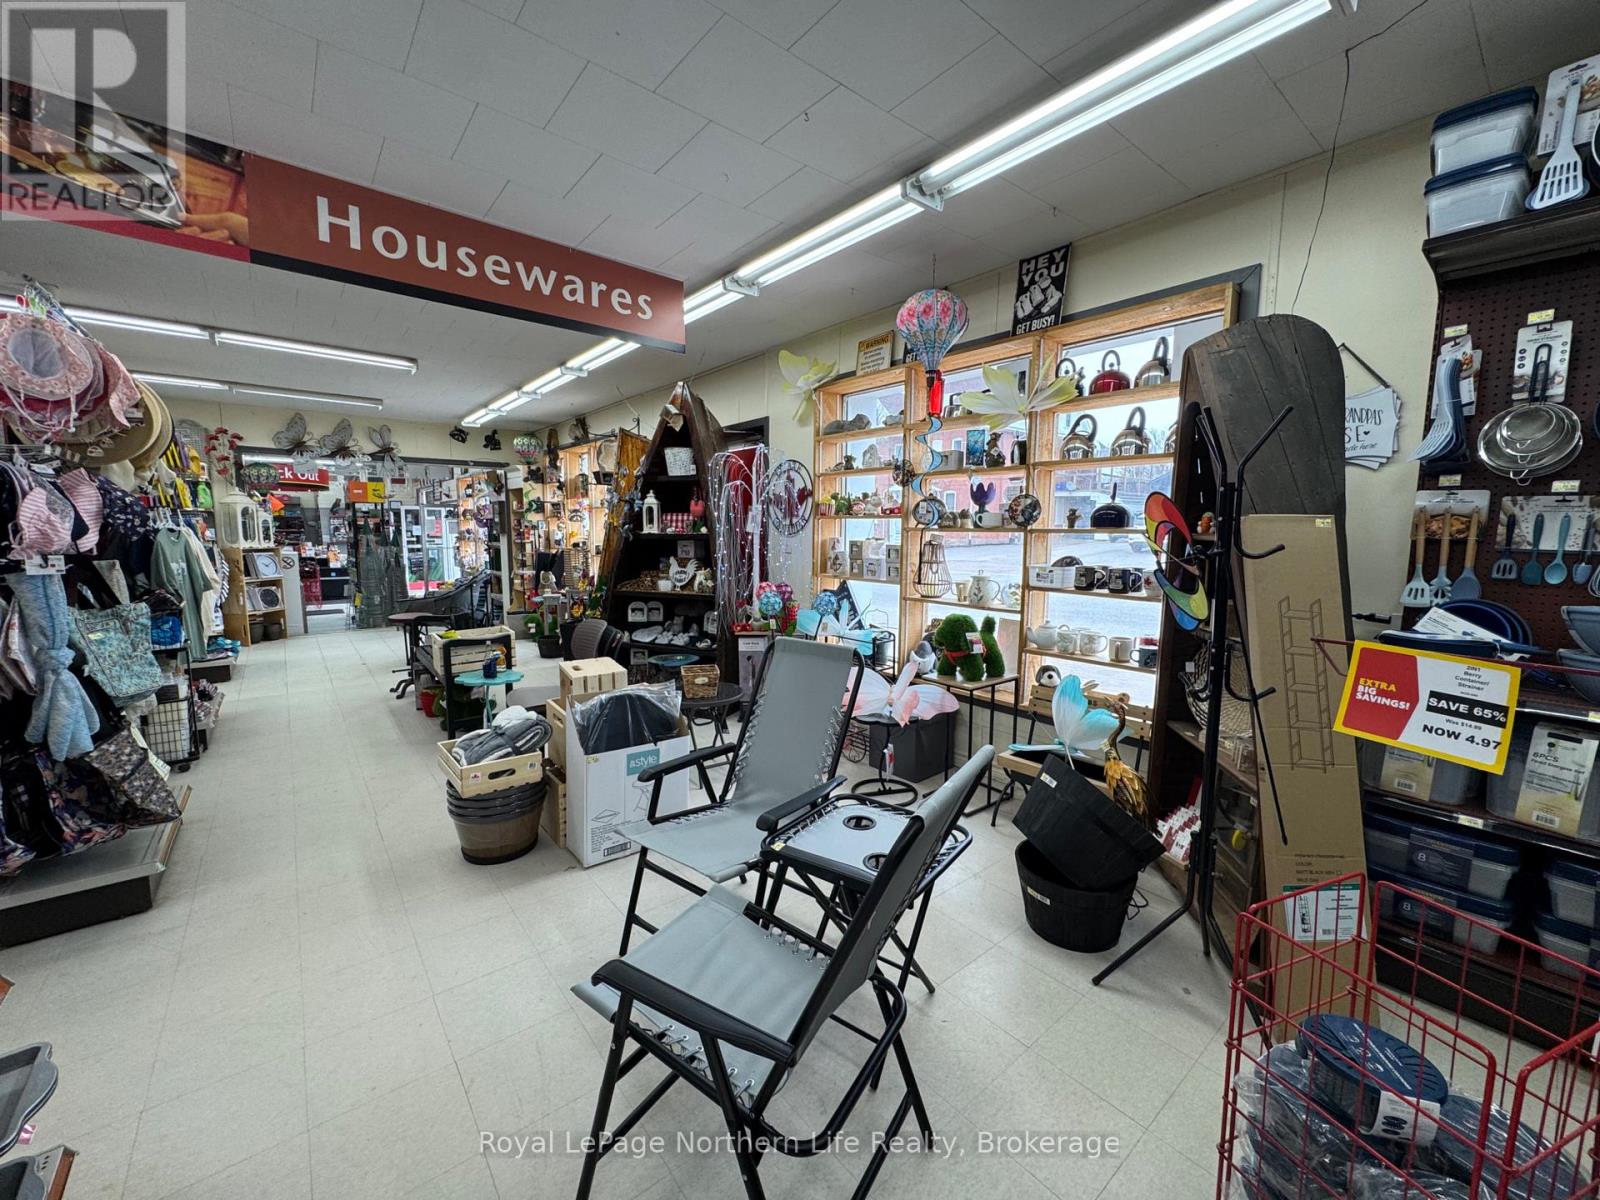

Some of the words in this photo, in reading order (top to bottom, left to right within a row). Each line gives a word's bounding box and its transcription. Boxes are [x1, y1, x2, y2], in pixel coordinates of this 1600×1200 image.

[316, 196, 653, 320] Housewares
[1022, 248, 1066, 275] HEY
[1021, 261, 1064, 288] YOU
[1016, 321, 1030, 335] GET
[1031, 314, 1056, 331] BUSY!
[1357, 684, 1377, 695] BIG
[1359, 677, 1397, 692] EXTRA
[1355, 691, 1411, 711] SAVINGS!
[1428, 697, 1470, 714] SAVE
[1473, 707, 1506, 722] 65%
[1445, 718, 1459, 726] Was
[1422, 724, 1461, 741] NOW
[1465, 735, 1502, 750] 4.97
